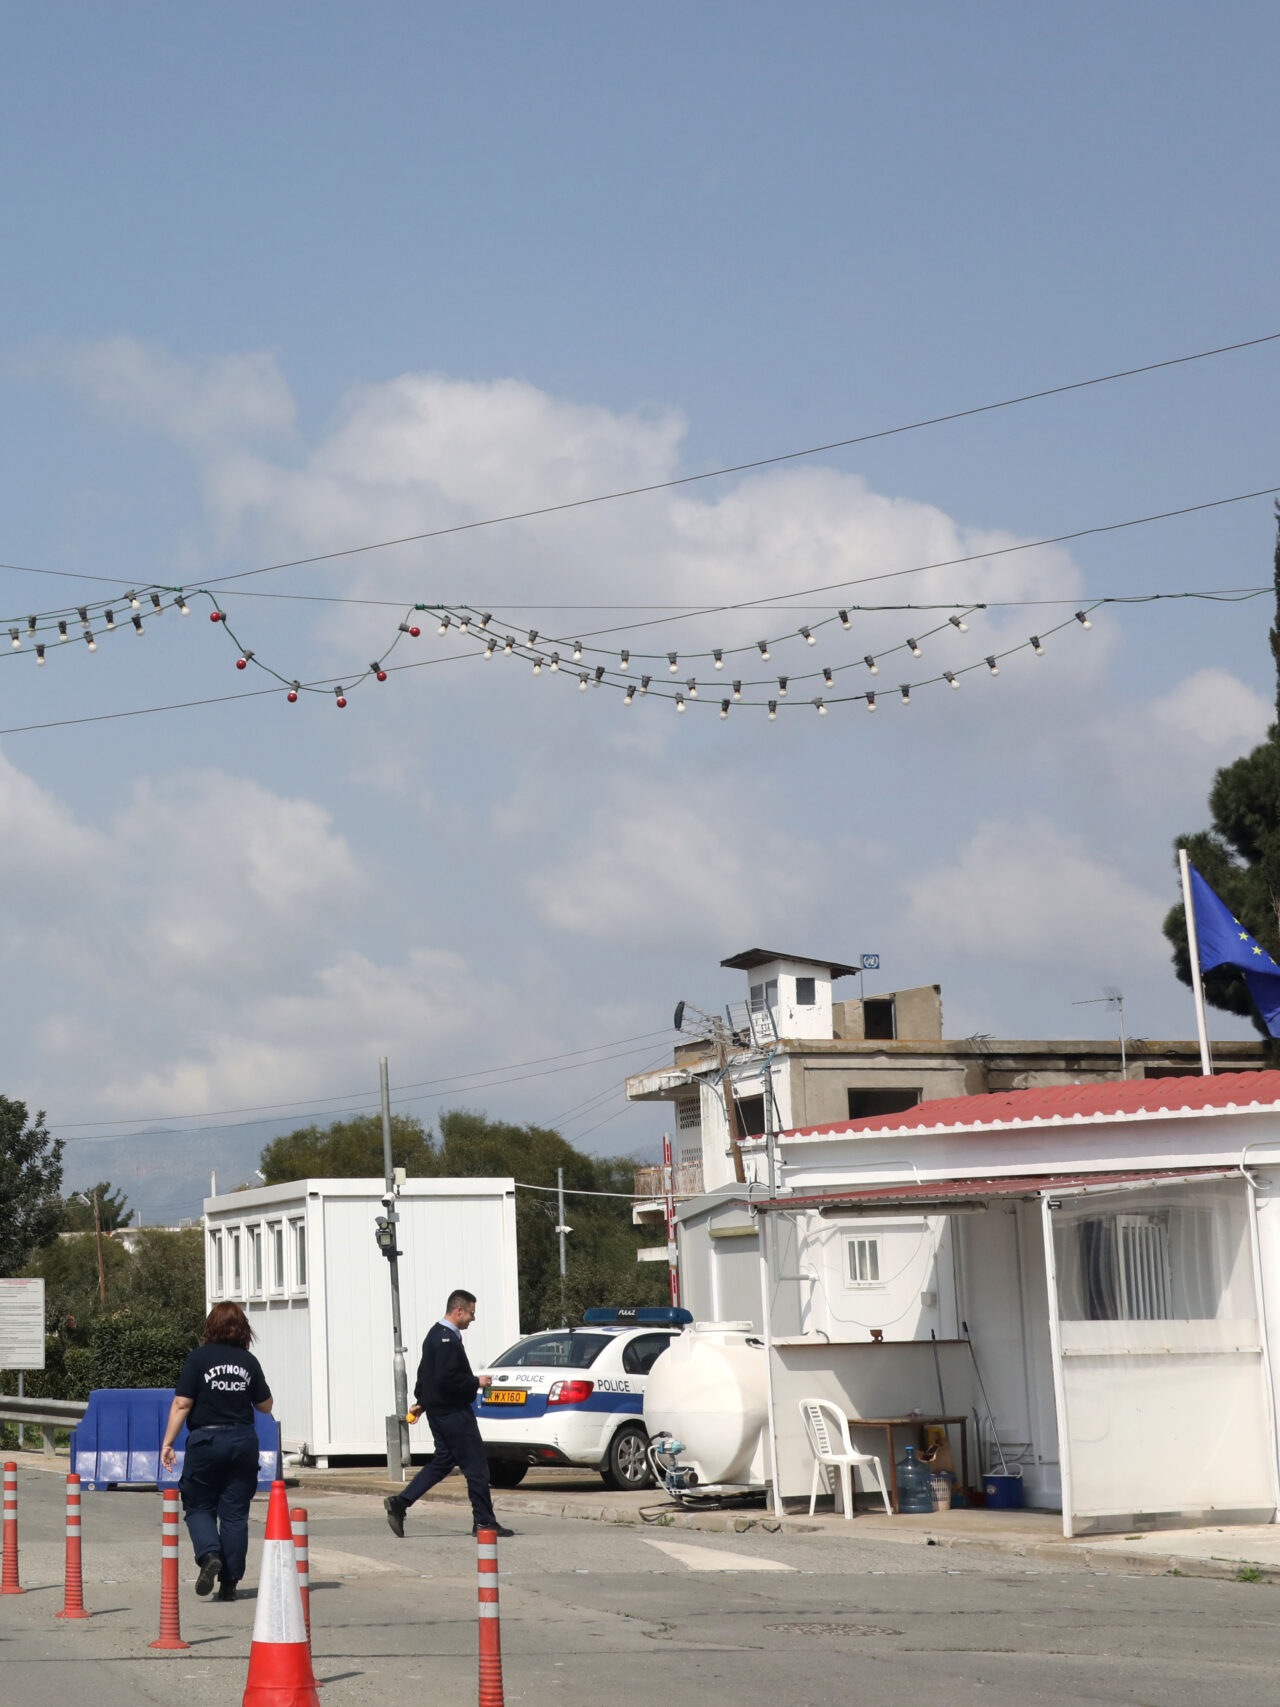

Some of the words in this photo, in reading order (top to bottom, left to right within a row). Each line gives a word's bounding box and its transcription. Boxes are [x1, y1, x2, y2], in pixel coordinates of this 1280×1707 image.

[203, 1364, 252, 1386] ΑΣΤΥΝΟΜΙΑ
[515, 1374, 545, 1383] POLICE
[211, 1380, 246, 1391] POLICE
[597, 1379, 631, 1392] POLICE
[487, 1391, 521, 1402] WX160
